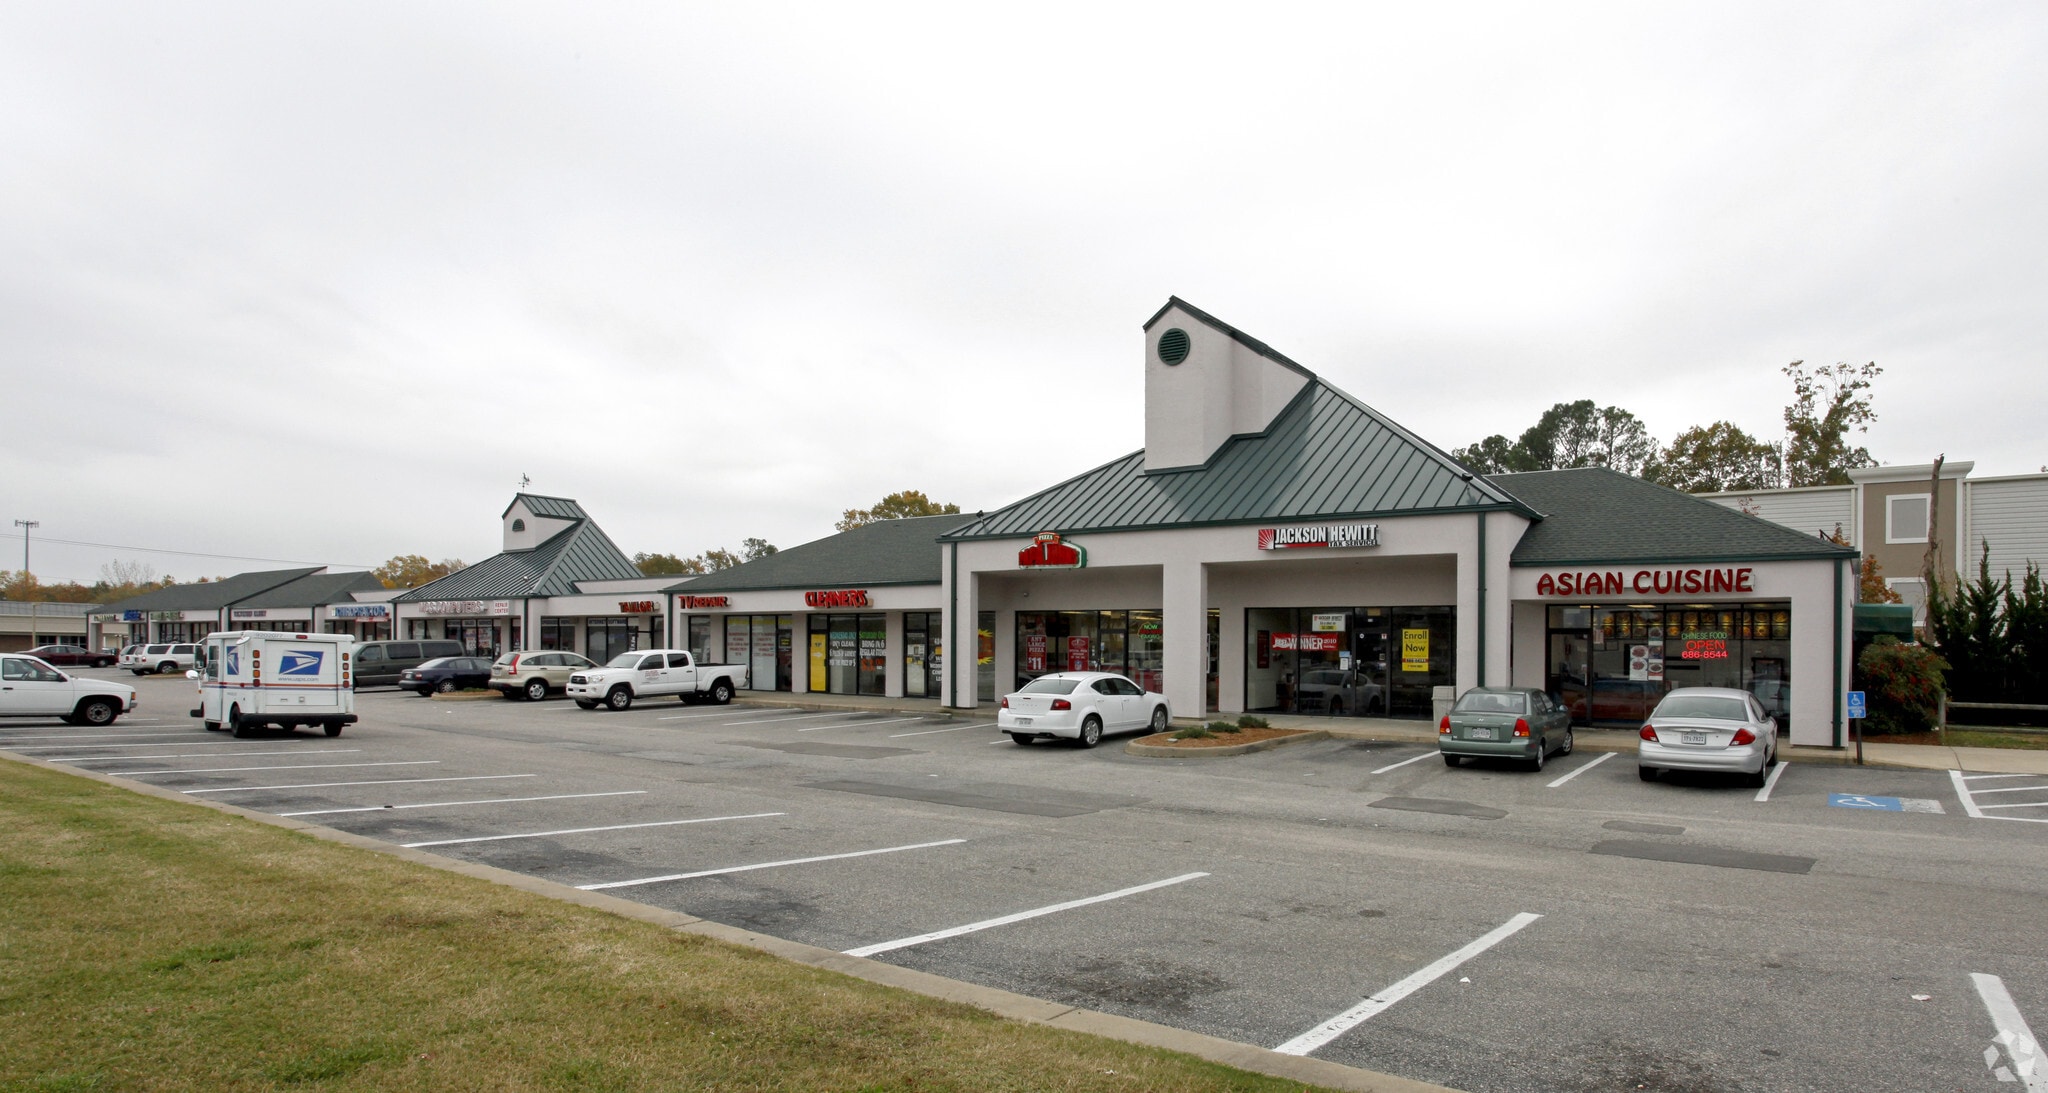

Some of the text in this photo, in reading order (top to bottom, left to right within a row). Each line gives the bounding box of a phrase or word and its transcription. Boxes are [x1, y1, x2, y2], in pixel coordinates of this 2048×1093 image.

[1275, 524, 1377, 544] JACKSON HEWITT
[1345, 539, 1376, 547] SERVICE
[1537, 567, 1753, 596] ASIAN CUISINE
[679, 595, 728, 609] TV REPAIR
[805, 590, 869, 608] CLEANERS
[437, 601, 484, 614] COMPUTERS
[1404, 631, 1427, 640] Enroll
[1681, 632, 1709, 640] CHINESE
[1405, 643, 1426, 652] Now
[1685, 640, 1726, 650] OPEN
[1681, 651, 1729, 659] 686-8544
[1028, 657, 1042, 670] $11
